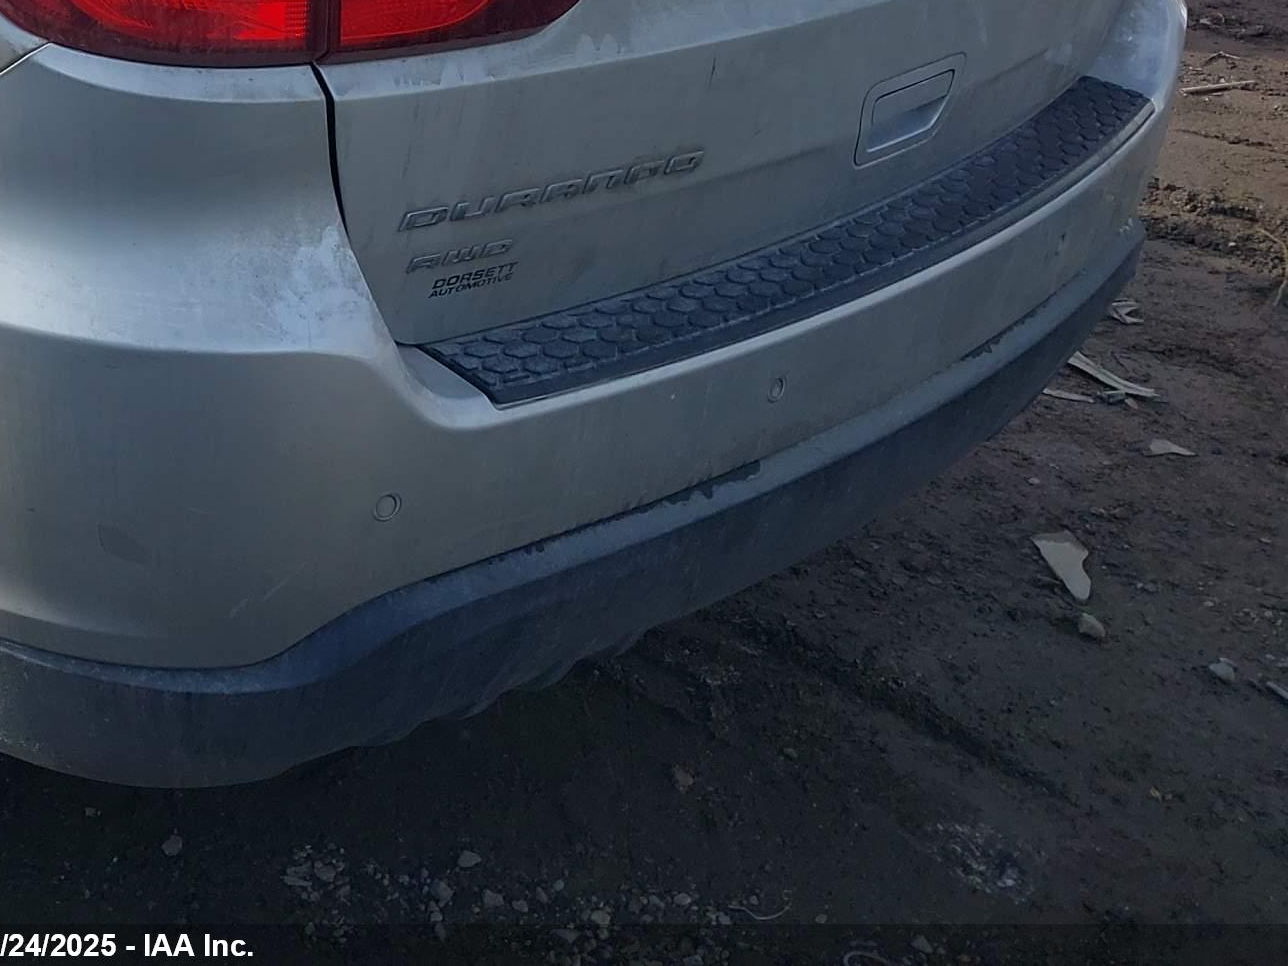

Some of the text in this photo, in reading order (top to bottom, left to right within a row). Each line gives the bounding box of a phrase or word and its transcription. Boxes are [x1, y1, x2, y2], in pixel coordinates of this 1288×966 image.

[398, 149, 705, 232] DURANGO
[406, 239, 513, 274] AWD
[428, 272, 514, 298] AUTOMOTIVE
[432, 261, 518, 289] DORSETT
